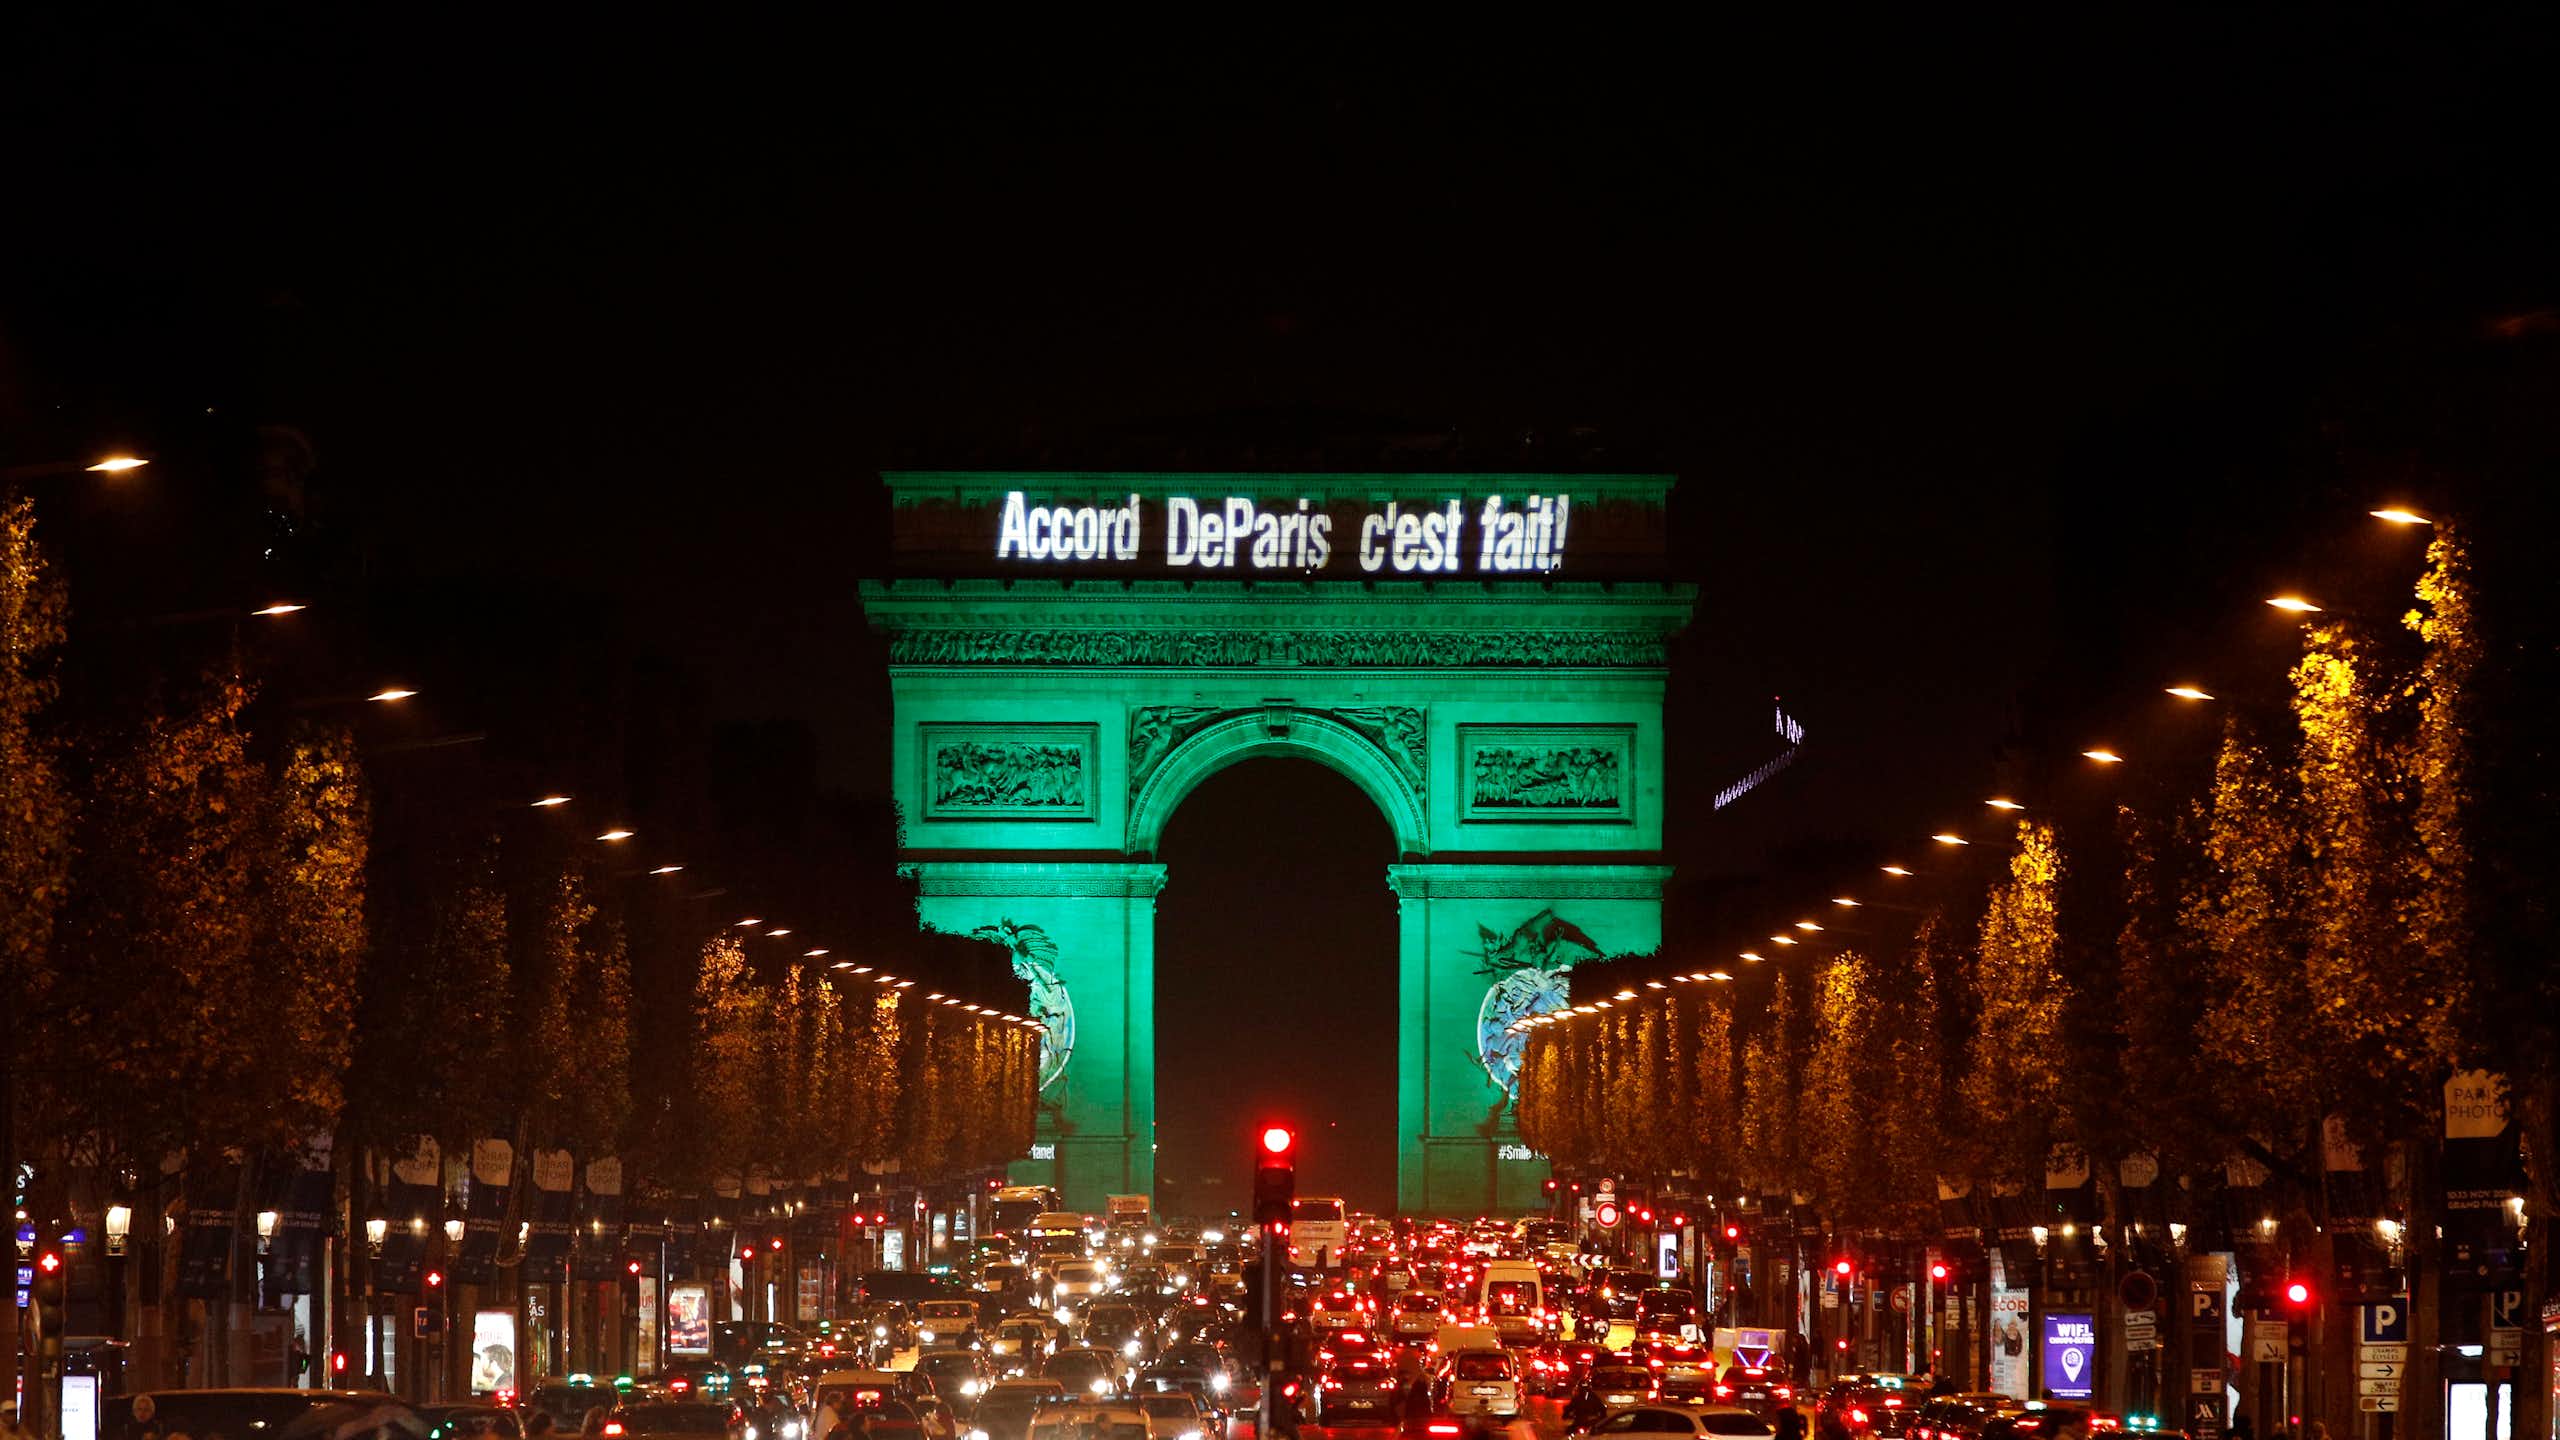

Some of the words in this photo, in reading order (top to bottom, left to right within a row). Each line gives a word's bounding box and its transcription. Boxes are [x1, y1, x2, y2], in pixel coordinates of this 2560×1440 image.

[998, 491, 1140, 560] Accord
[1166, 497, 1332, 569] DeParis
[1360, 500, 1462, 571] c'est
[1478, 494, 1570, 571] fait!
[2449, 1104, 2505, 1119] PHOTO
[1498, 1144, 1549, 1160] #Smile
[2375, 1305, 2397, 1336] P
